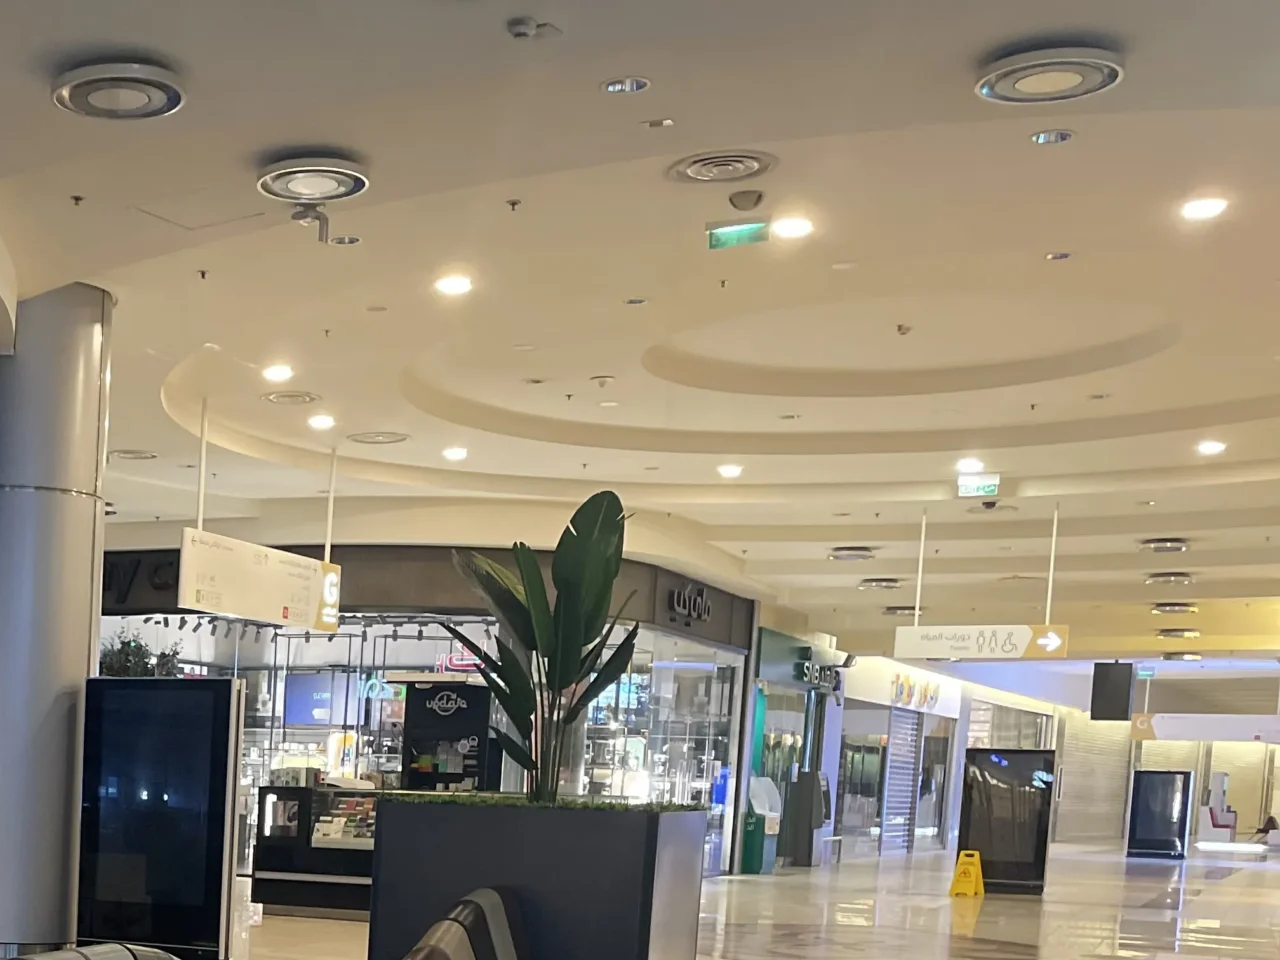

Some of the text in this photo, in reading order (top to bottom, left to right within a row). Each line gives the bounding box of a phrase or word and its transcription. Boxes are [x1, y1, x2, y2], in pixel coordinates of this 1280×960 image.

[323, 571, 339, 604] G
[803, 662, 820, 684] SNB
[426, 694, 468, 711] update
[1136, 717, 1148, 730] G
